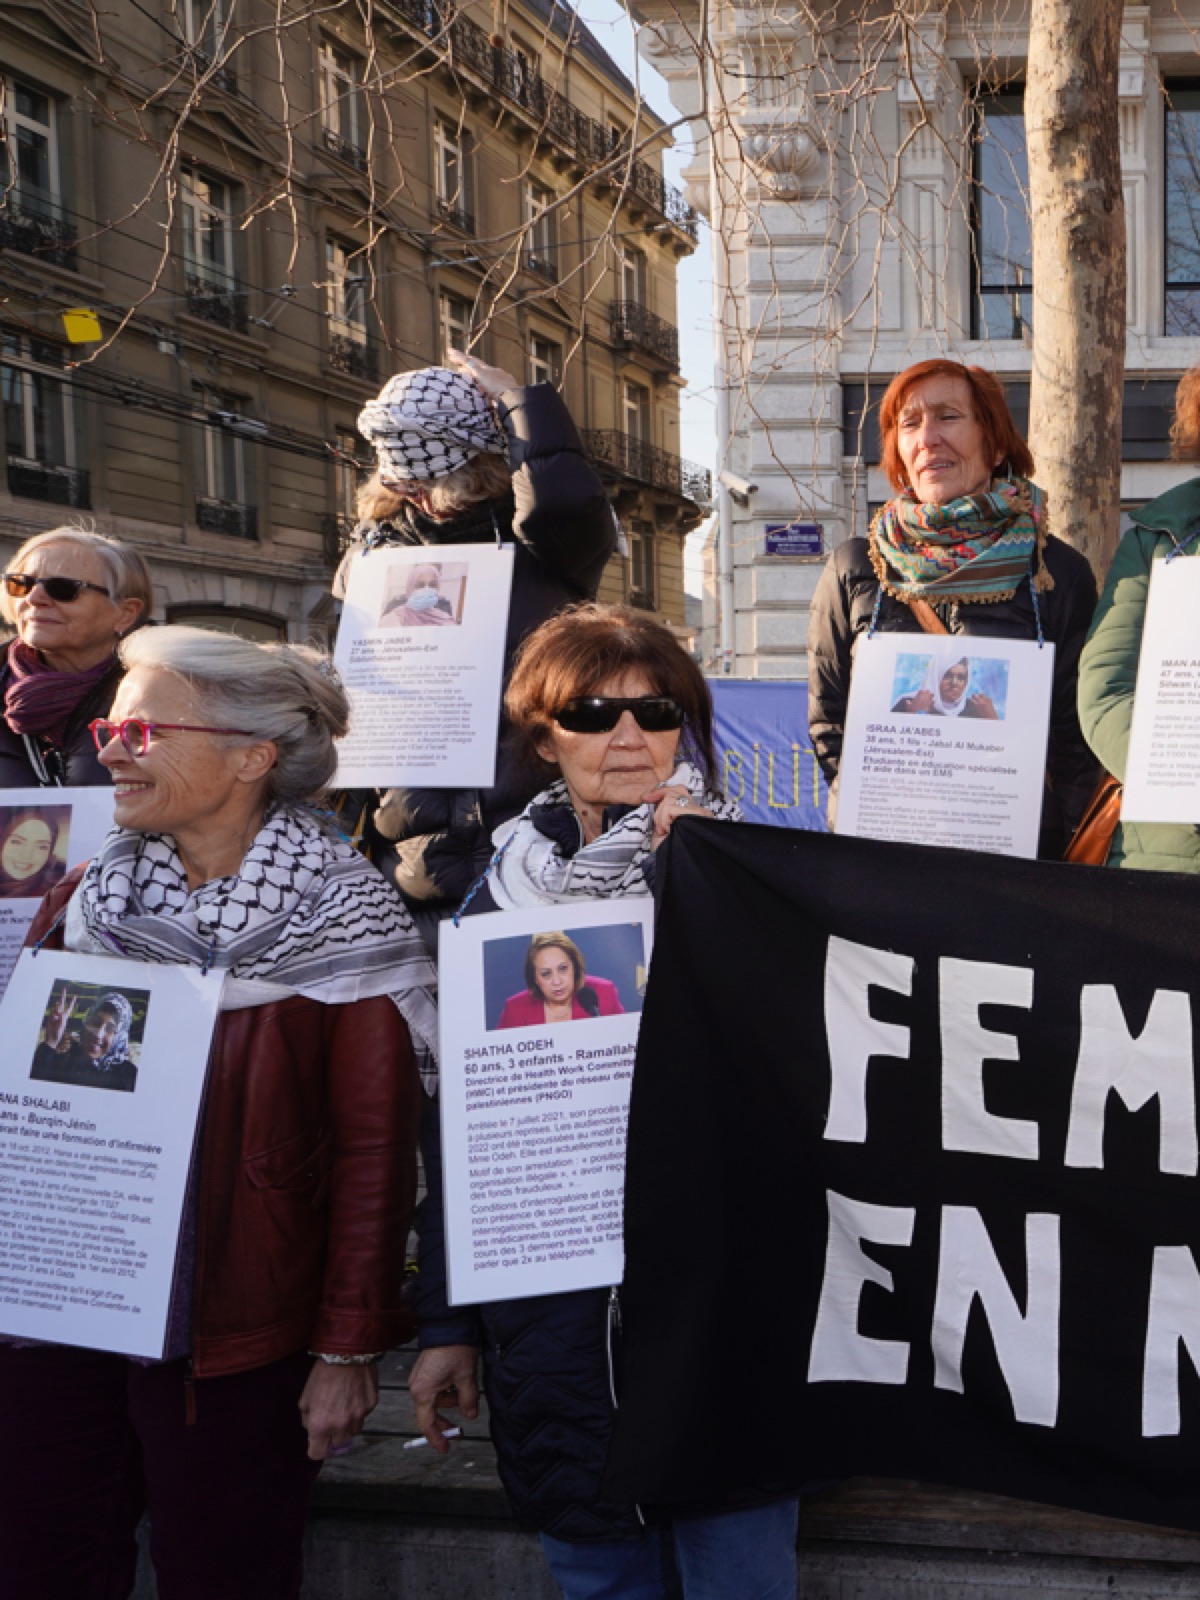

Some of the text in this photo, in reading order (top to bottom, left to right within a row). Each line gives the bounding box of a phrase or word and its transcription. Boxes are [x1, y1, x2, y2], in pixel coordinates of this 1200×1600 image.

[464, 1039, 554, 1060] SHATHA ODEH
[518, 1054, 564, 1068] enfants
[807, 1189, 1061, 1428] EN
